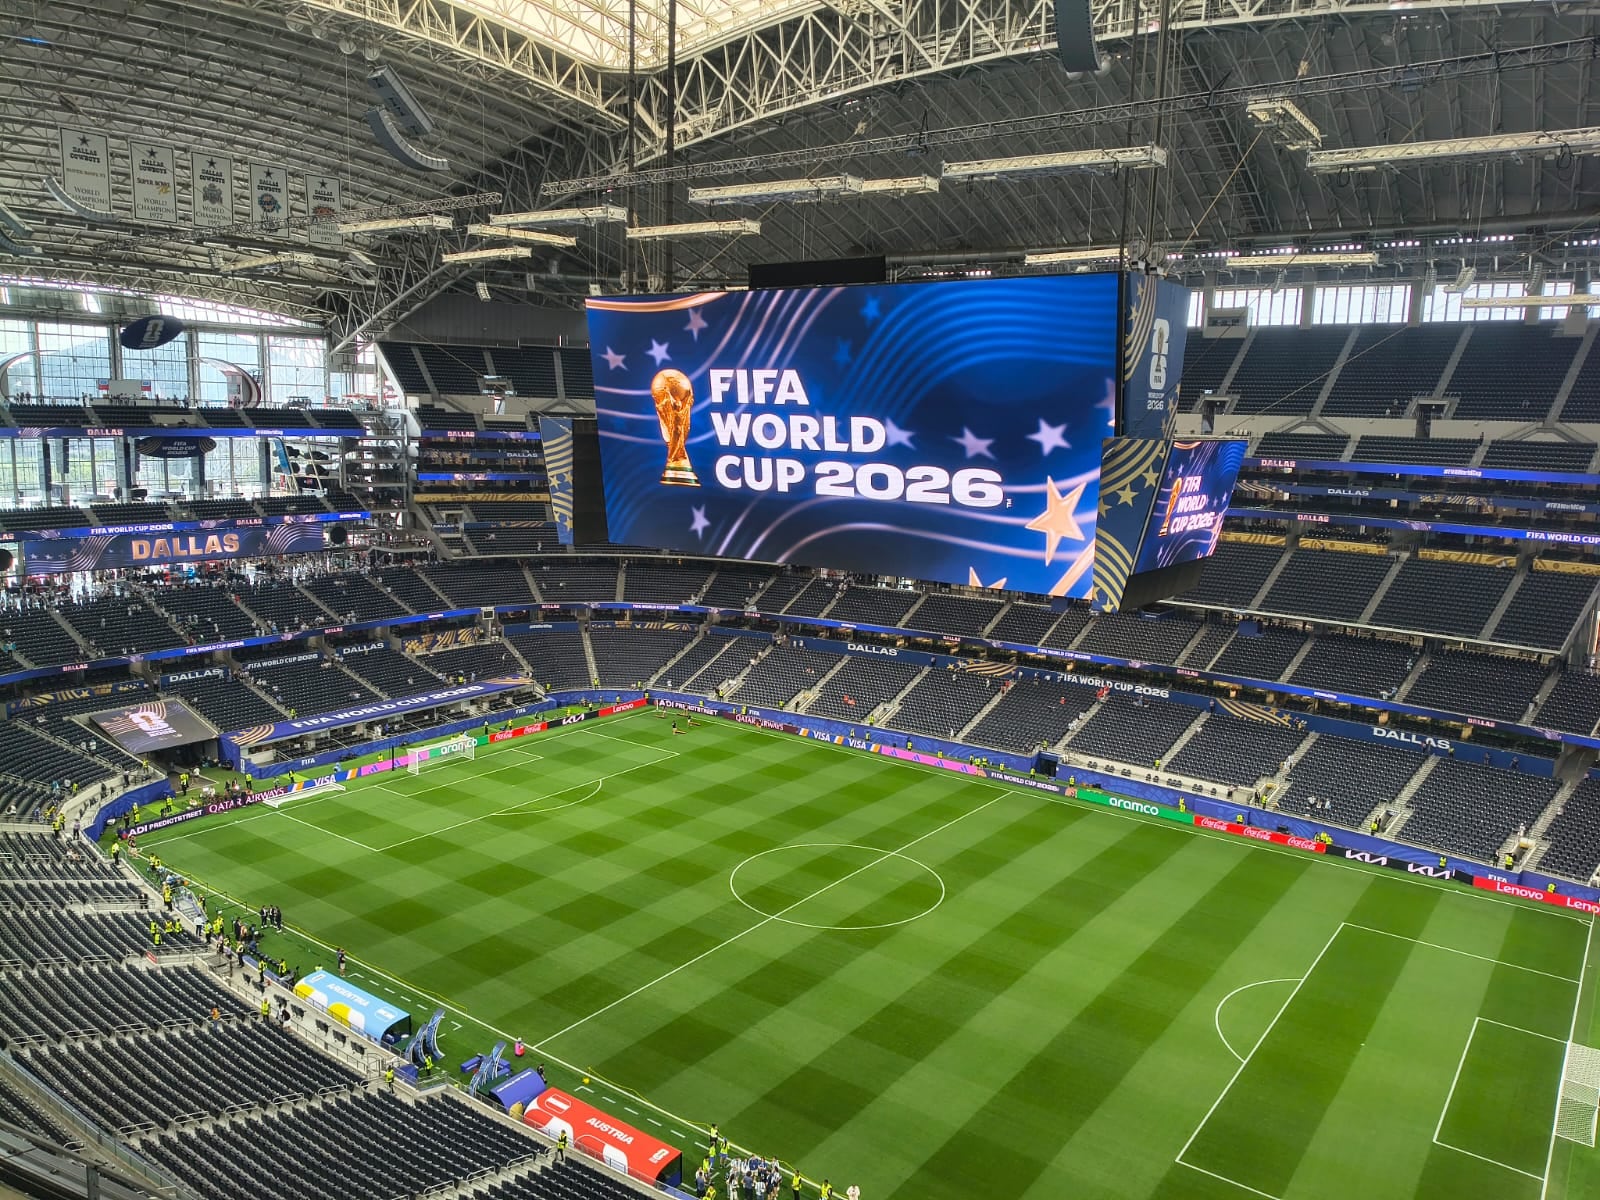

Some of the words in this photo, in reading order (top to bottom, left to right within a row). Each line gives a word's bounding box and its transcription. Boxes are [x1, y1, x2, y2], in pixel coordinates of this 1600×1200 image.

[73, 147, 97, 156] DALLAS
[70, 153, 100, 163] COWBOYS
[139, 165, 167, 174] COWBOYS
[200, 174, 225, 184] COWBOYS
[74, 186, 100, 196] WORLD
[143, 197, 167, 206] WORLD
[137, 203, 174, 214] CHAMPIONS
[202, 205, 224, 214] WORLD
[196, 211, 231, 222] CHAMPIONS
[710, 369, 810, 405] FIFA
[1147, 400, 1164, 410] 2026
[711, 412, 886, 453] WORLD
[1261, 459, 1296, 467] DALLAS
[715, 455, 805, 492] CUP
[814, 461, 1003, 507] 2026
[1183, 476, 1202, 492] FIFA
[1177, 495, 1207, 513] WORLD
[1170, 515, 1188, 534] CUP
[1186, 512, 1216, 530] 2026
[1297, 514, 1329, 522] DALLAS
[1526, 531, 1545, 540] FIFA
[1546, 533, 1580, 542] WORLD
[132, 533, 239, 560] DALLAS
[343, 642, 384, 654] DALLAS
[847, 643, 898, 656] DALLAS
[262, 659, 284, 667] WORLD
[169, 669, 221, 682] DALLAS
[1080, 676, 1112, 688] WORLD
[1114, 682, 1133, 691] CUP
[1134, 686, 1169, 698] 2026
[291, 717, 334, 728] FIFA
[334, 703, 396, 719] WORLD
[397, 696, 429, 706] CUP
[429, 685, 484, 699] 2026
[613, 703, 633, 712] Lenovo
[736, 715, 755, 724] QATAR
[1467, 718, 1496, 727] DALLAS
[813, 731, 830, 742] VISA
[1373, 728, 1450, 749] DALLAS
[441, 738, 477, 755] aramco
[848, 738, 866, 749] VISA
[314, 775, 336, 787] VISA
[1004, 775, 1024, 784] WORLD
[1025, 778, 1036, 786] CUP
[1037, 780, 1058, 792] 2026
[209, 799, 242, 813] QATAR
[246, 787, 285, 804] AIRWAYS
[1109, 797, 1159, 815] aramco
[128, 824, 148, 836] ADI
[149, 809, 203, 830] PREDICTSTREET
[1488, 874, 1507, 883] FIFA
[1496, 882, 1544, 900] Lenovo
[327, 984, 369, 1007] ARGENTINA
[586, 1117, 634, 1144] AUSTRIA
